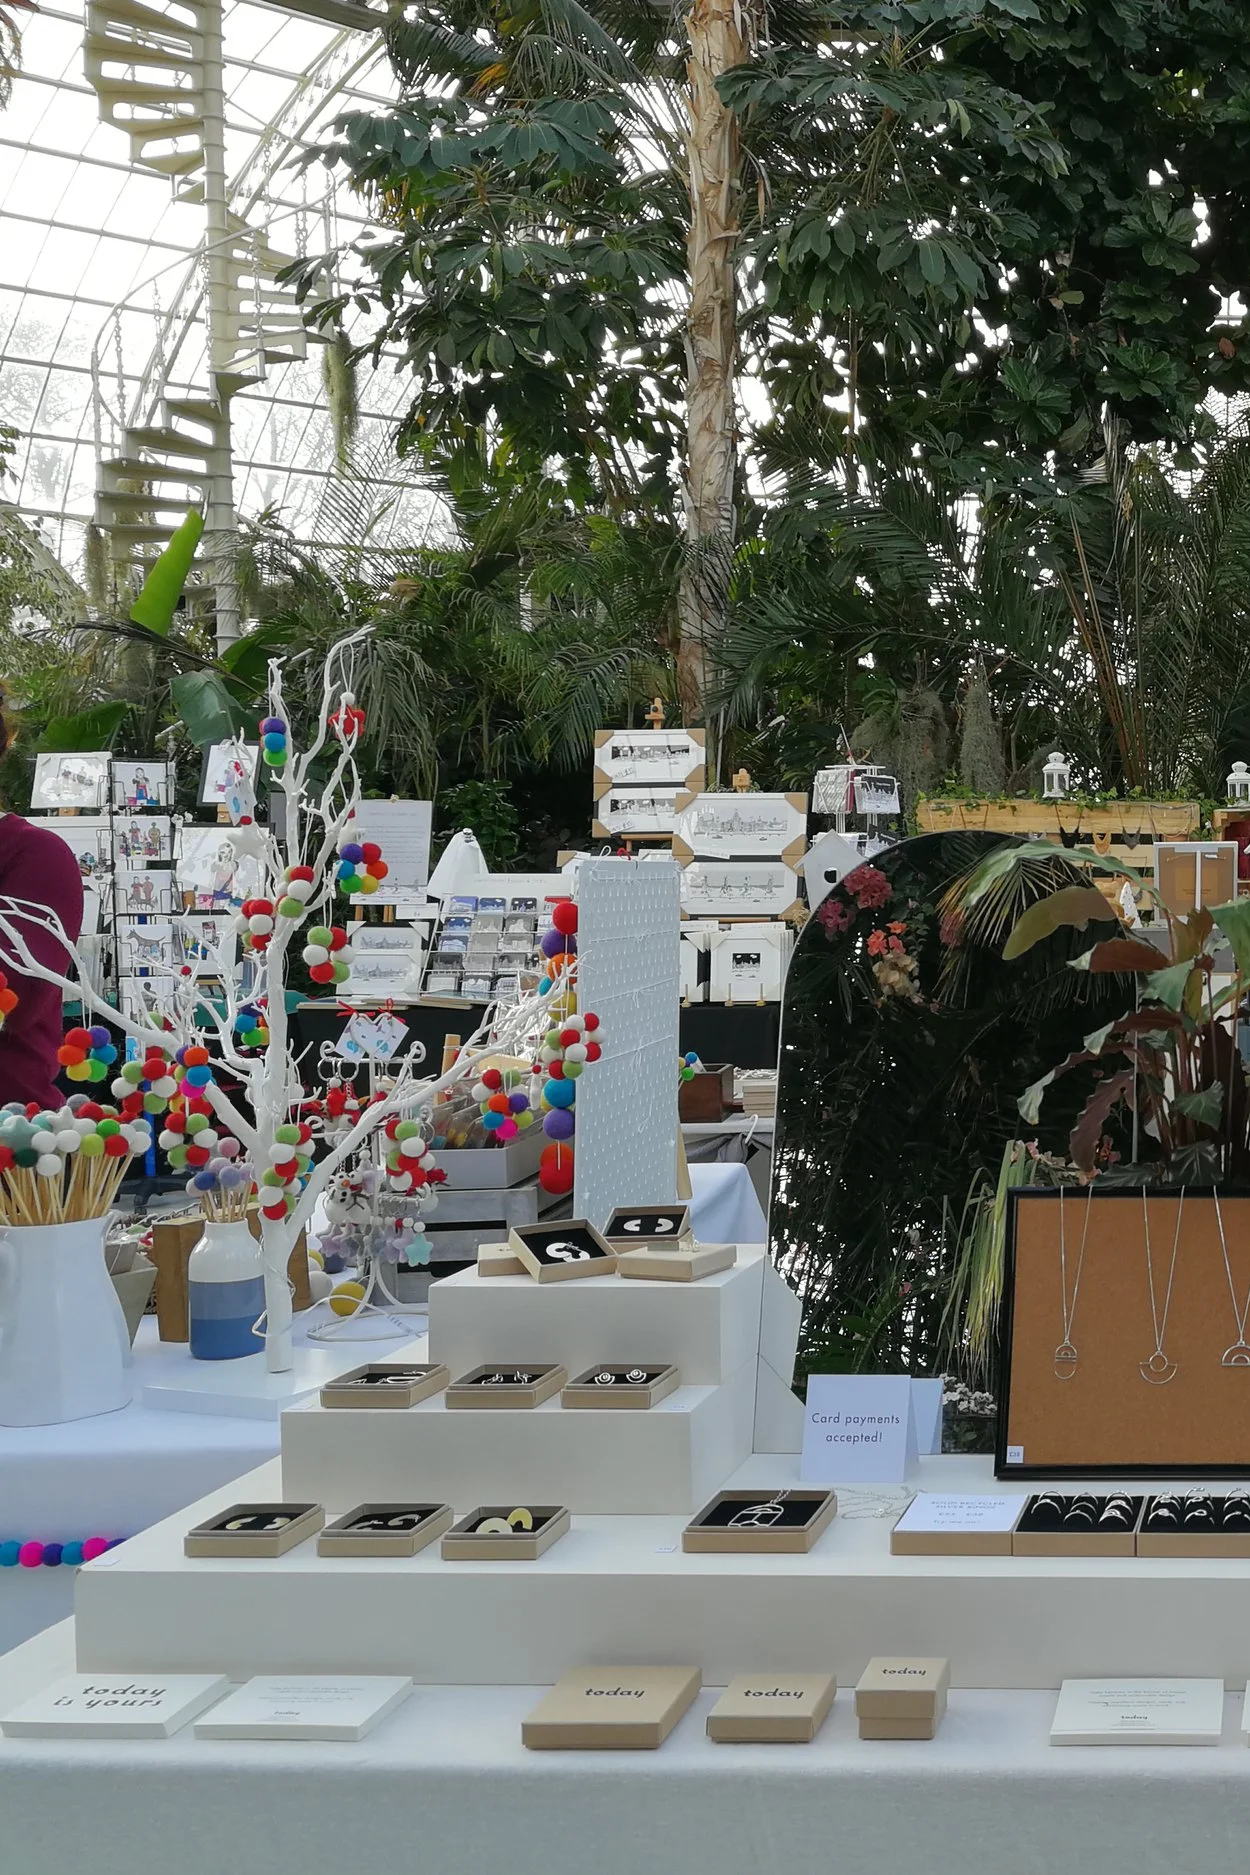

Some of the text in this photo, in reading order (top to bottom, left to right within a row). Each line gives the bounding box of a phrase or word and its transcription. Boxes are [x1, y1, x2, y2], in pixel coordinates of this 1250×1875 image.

[811, 1412, 900, 1427] Card payments
[825, 1430, 883, 1445] accepted!
[882, 1668, 927, 1676] today
[82, 1684, 167, 1698] today
[585, 1687, 645, 1698] today
[744, 1688, 804, 1699] today
[53, 1696, 162, 1709] is yours
